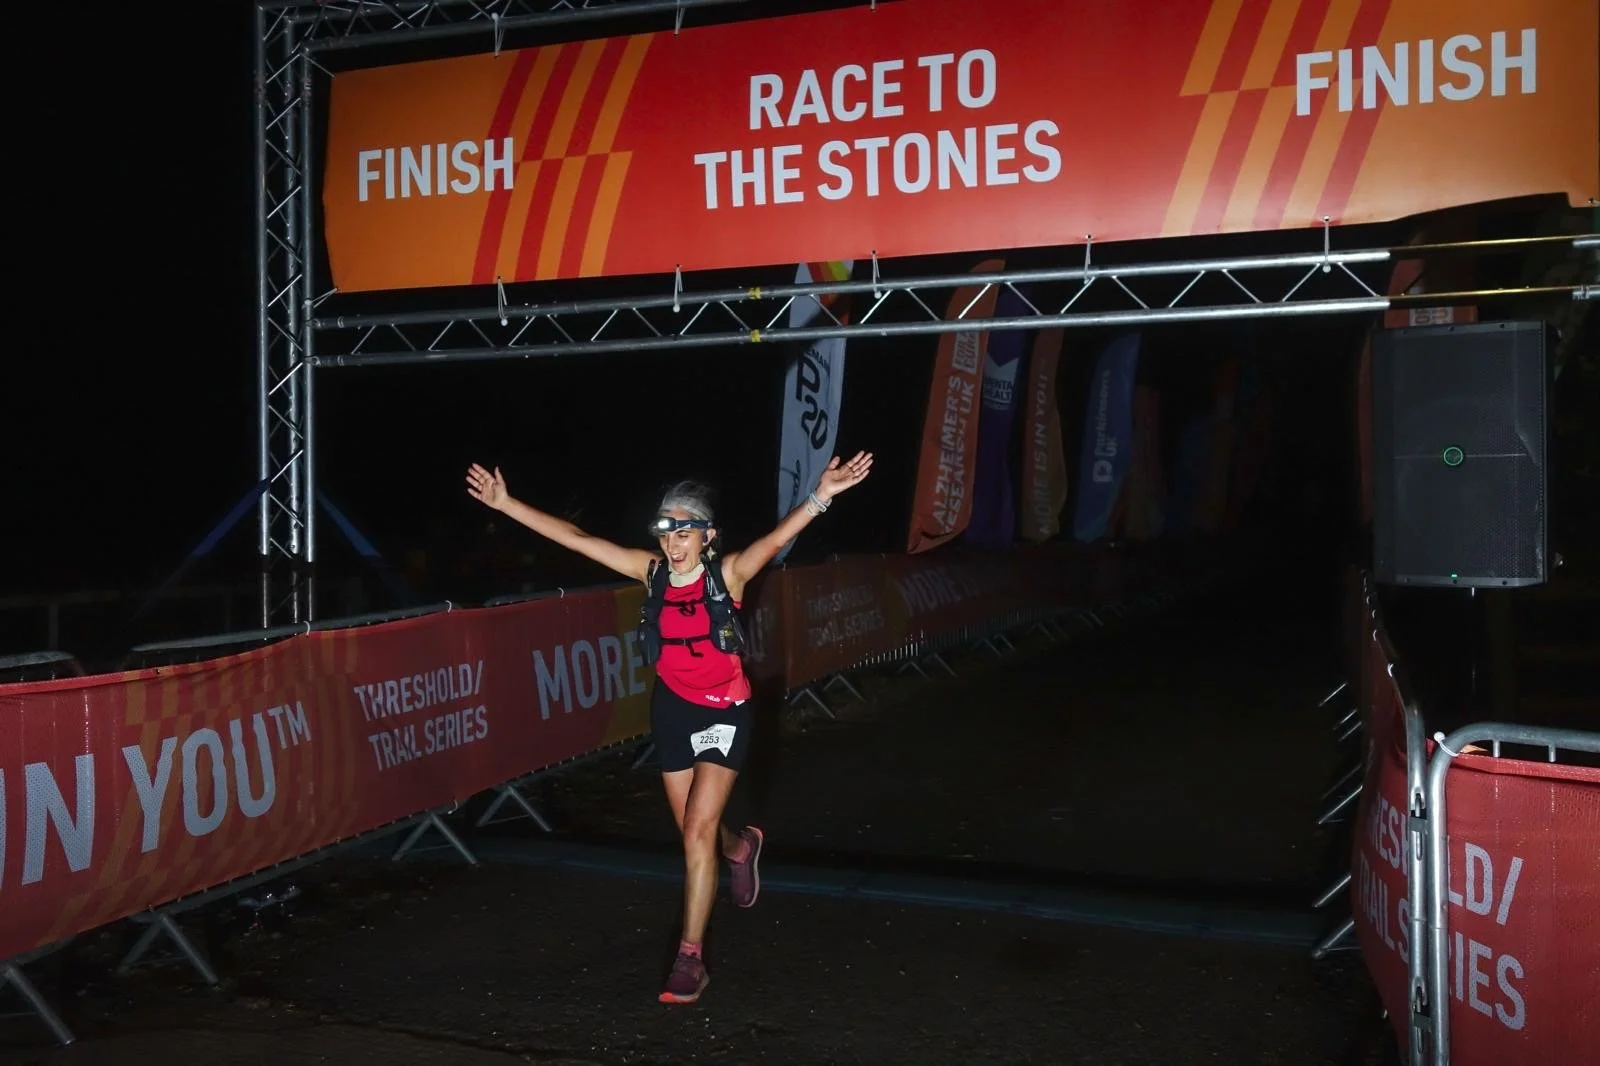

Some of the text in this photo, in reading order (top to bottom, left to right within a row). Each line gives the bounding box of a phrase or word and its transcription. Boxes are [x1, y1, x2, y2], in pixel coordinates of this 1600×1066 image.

[749, 48, 997, 130] RACE TO
[1296, 28, 1536, 116] FINISH
[357, 137, 515, 203] FINISH
[694, 120, 1062, 210] THE STONES
[958, 380, 976, 414] UK
[354, 660, 486, 721] THRESHOLD/
[532, 628, 648, 721] MORE
[368, 706, 489, 772] TRAIL SERIES
[699, 735, 720, 745] 2253
